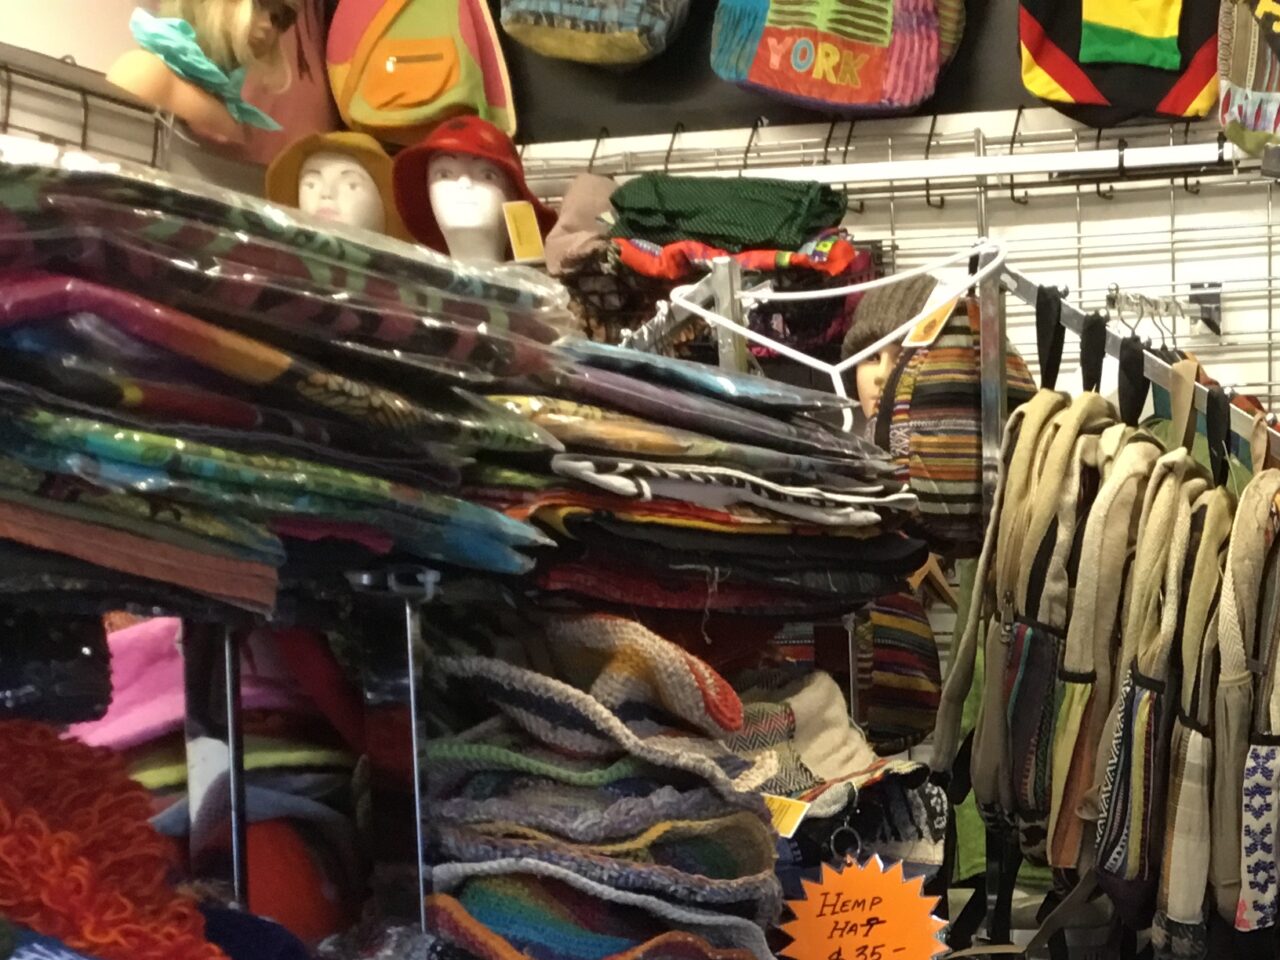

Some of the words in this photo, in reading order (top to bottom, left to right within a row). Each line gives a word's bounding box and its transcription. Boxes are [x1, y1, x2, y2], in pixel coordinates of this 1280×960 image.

[766, 35, 870, 88] YORK
[816, 892, 883, 918] HEMP
[827, 917, 887, 939] HAT
